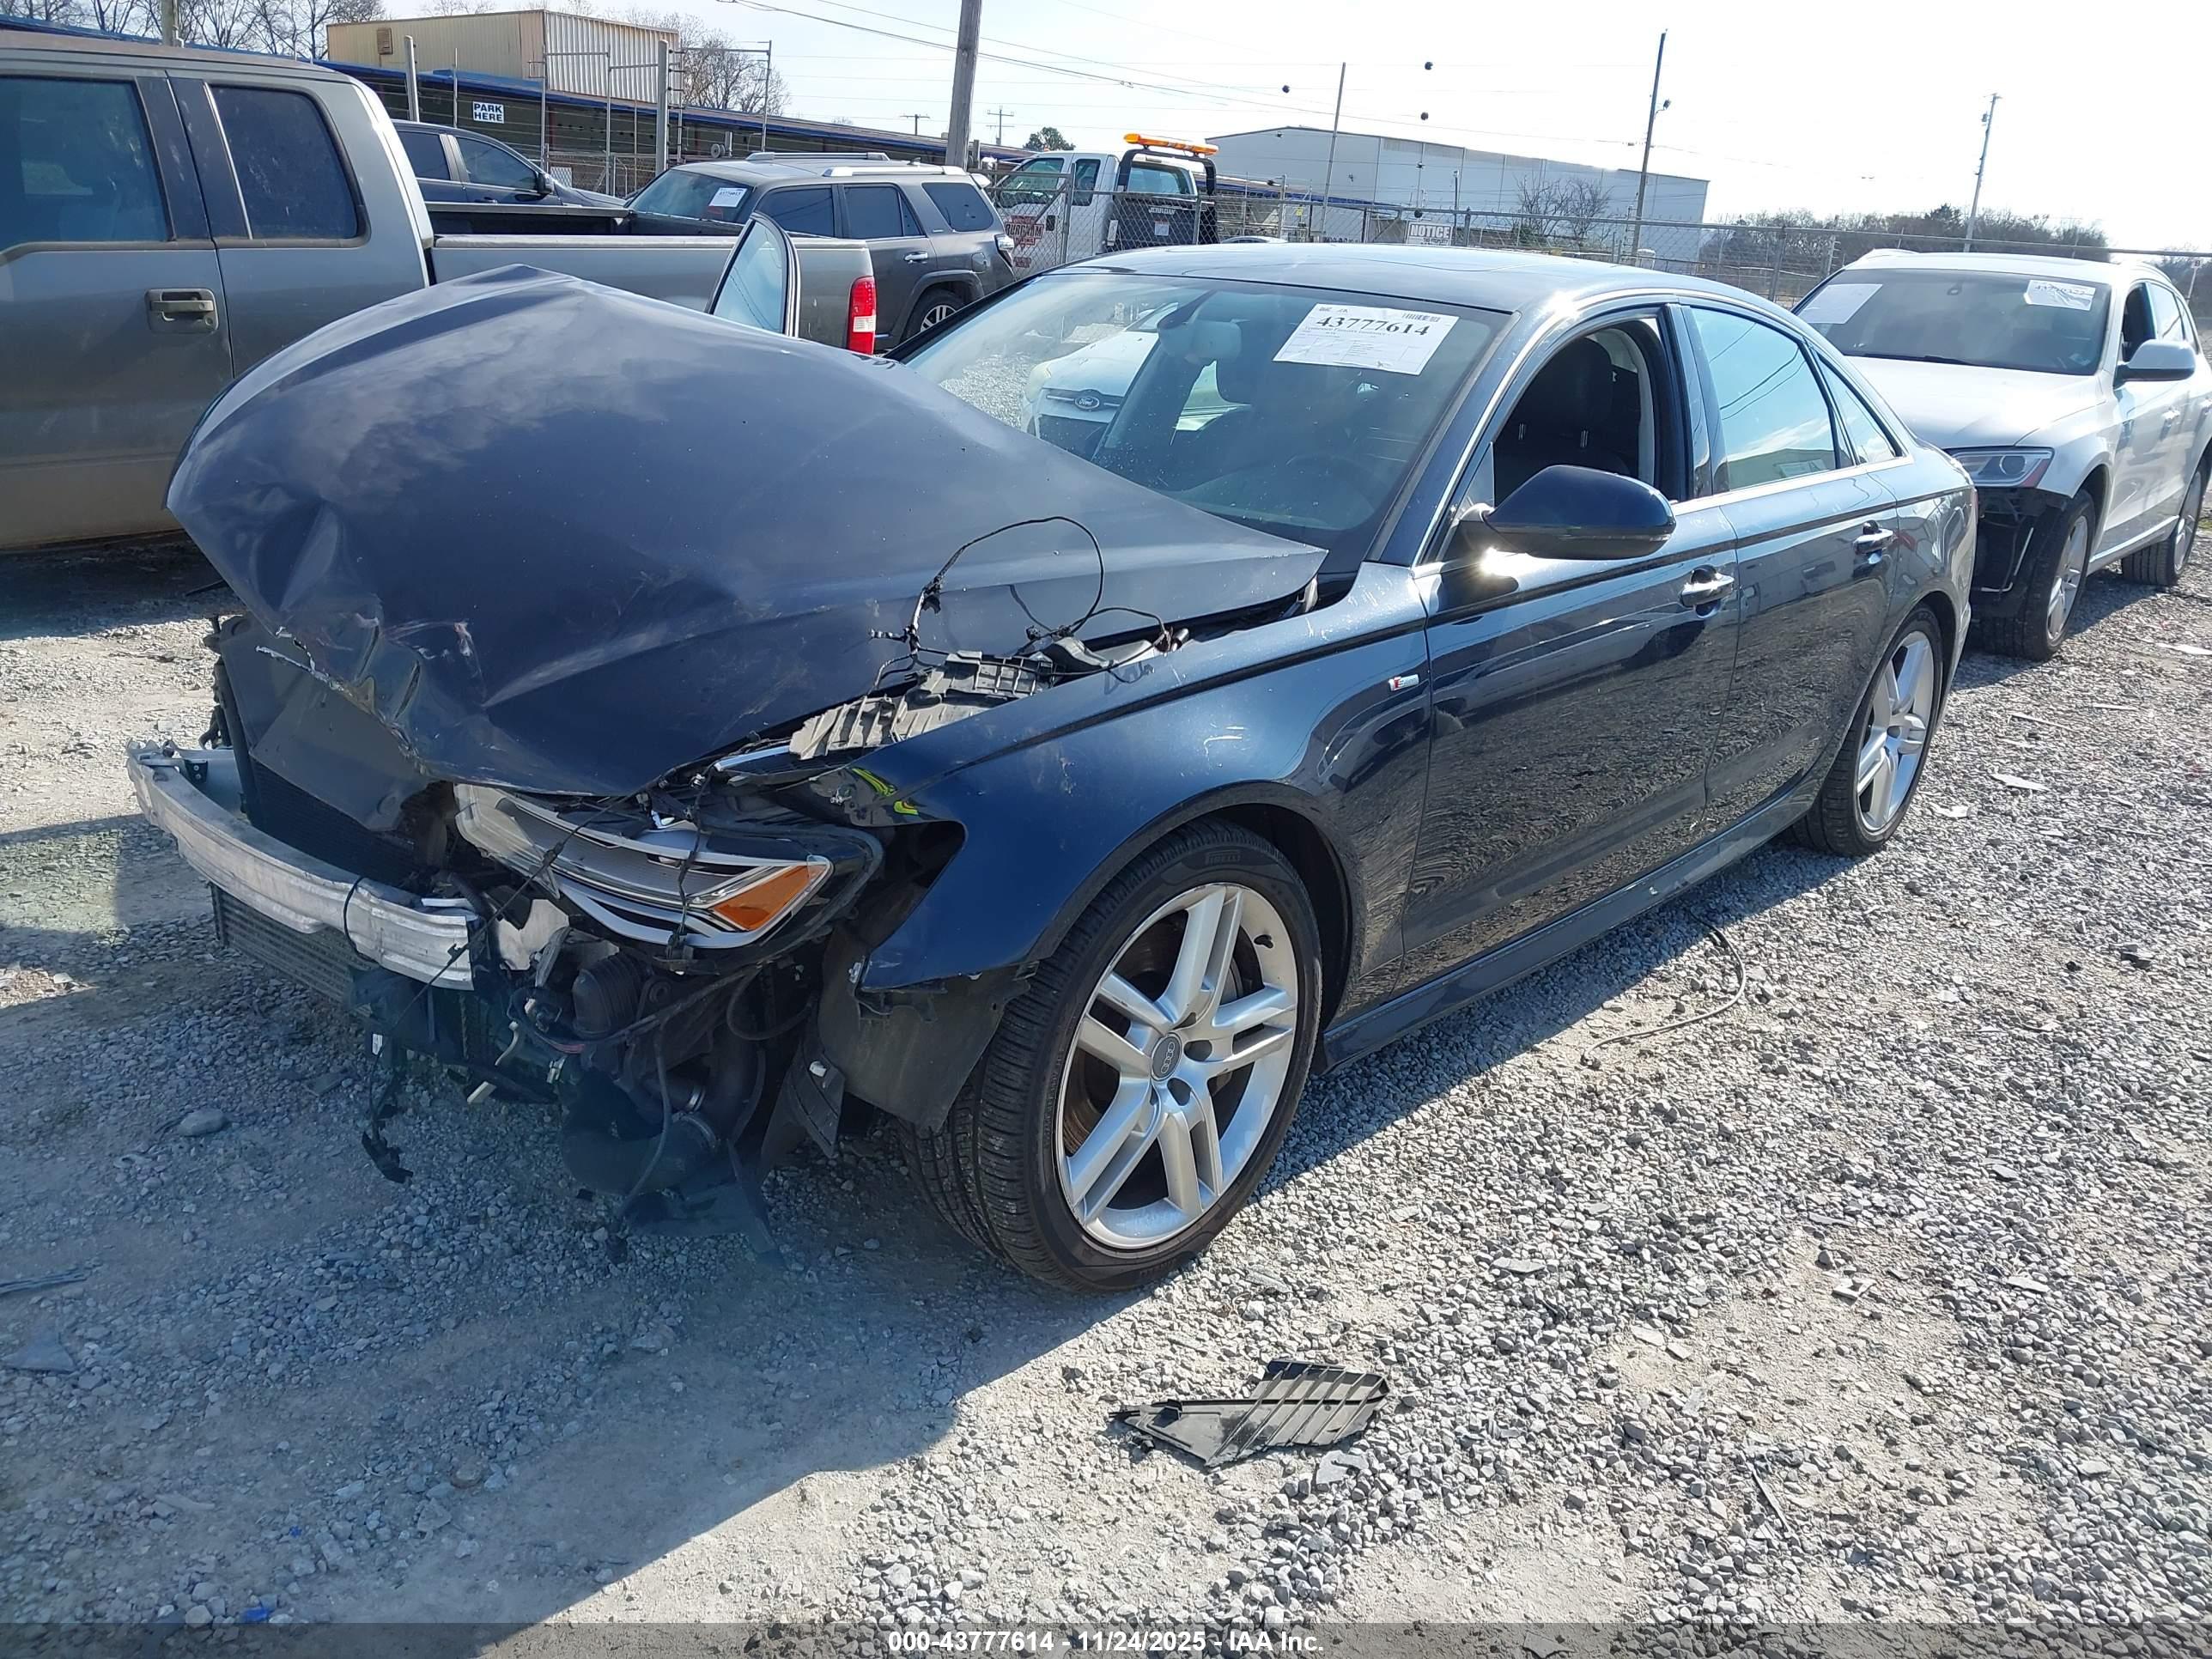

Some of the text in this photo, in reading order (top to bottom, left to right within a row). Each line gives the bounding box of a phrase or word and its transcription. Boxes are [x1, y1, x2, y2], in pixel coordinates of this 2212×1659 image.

[474, 103, 502, 113] PARK
[474, 112, 502, 121] HERE
[1410, 224, 1450, 239] NOTICE
[1316, 316, 1431, 336] 43777614
